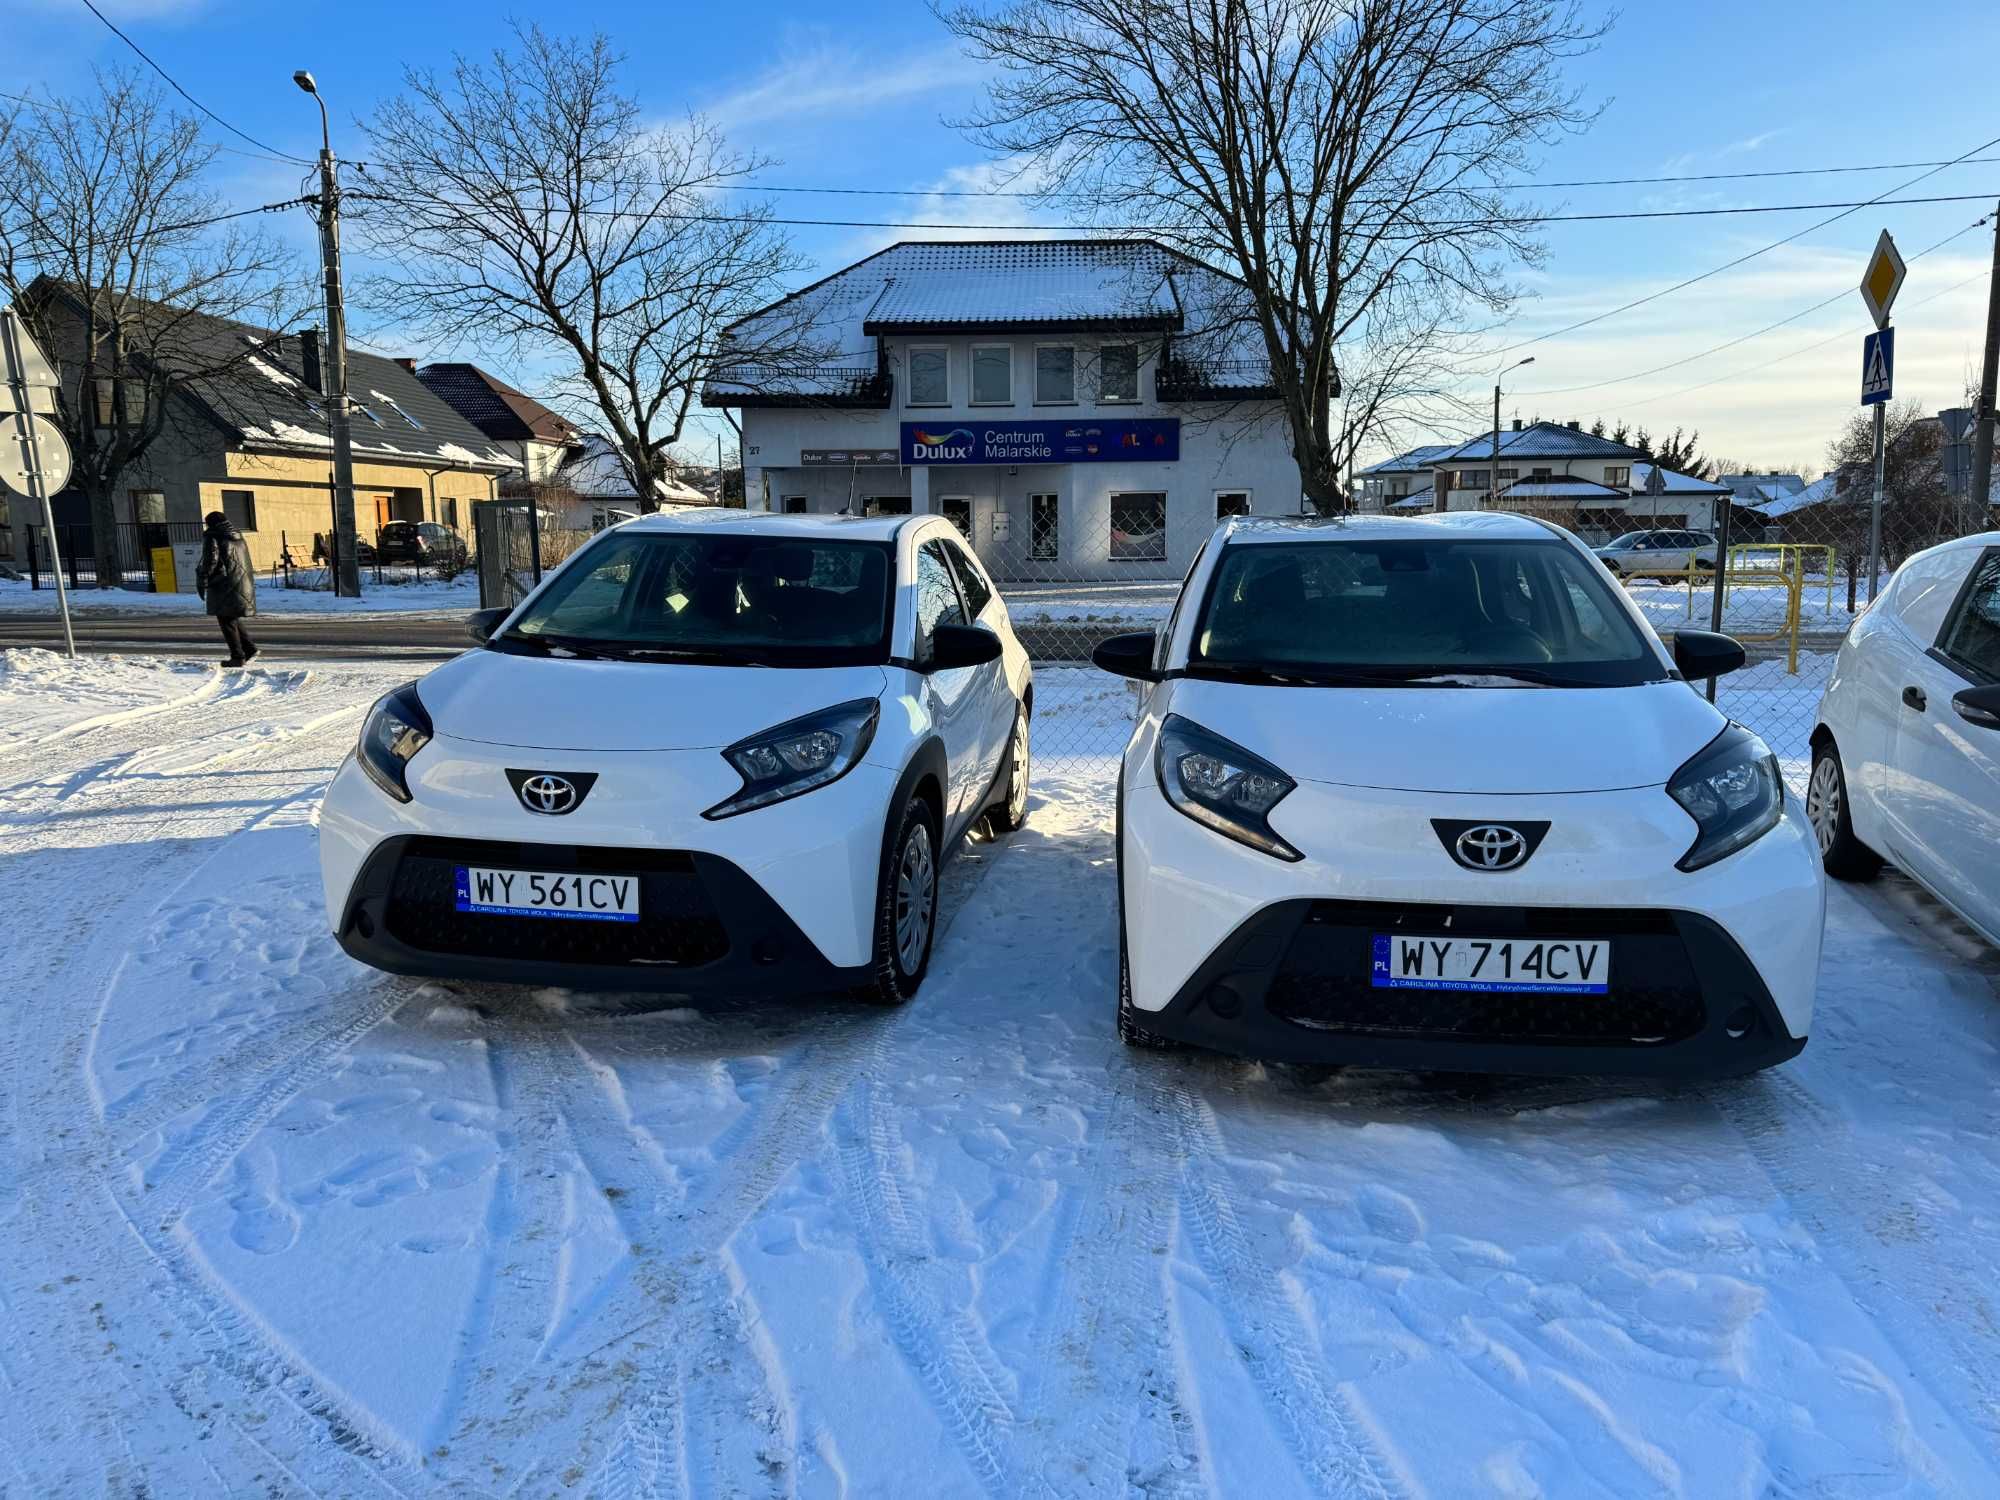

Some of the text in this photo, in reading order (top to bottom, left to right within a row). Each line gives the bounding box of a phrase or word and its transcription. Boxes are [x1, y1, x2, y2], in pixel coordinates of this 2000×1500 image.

[984, 430, 1045, 444] Centrum
[749, 446, 760, 455] 27
[912, 443, 968, 460] Dulux
[984, 444, 1052, 458] Malarskie
[457, 889, 469, 898] PL
[476, 872, 629, 910] WY 561CV
[476, 905, 507, 913] CAROLINA
[1401, 940, 1599, 980] WY 714CV
[1374, 961, 1388, 972] PL
[1399, 980, 1439, 988] CAROLINA
